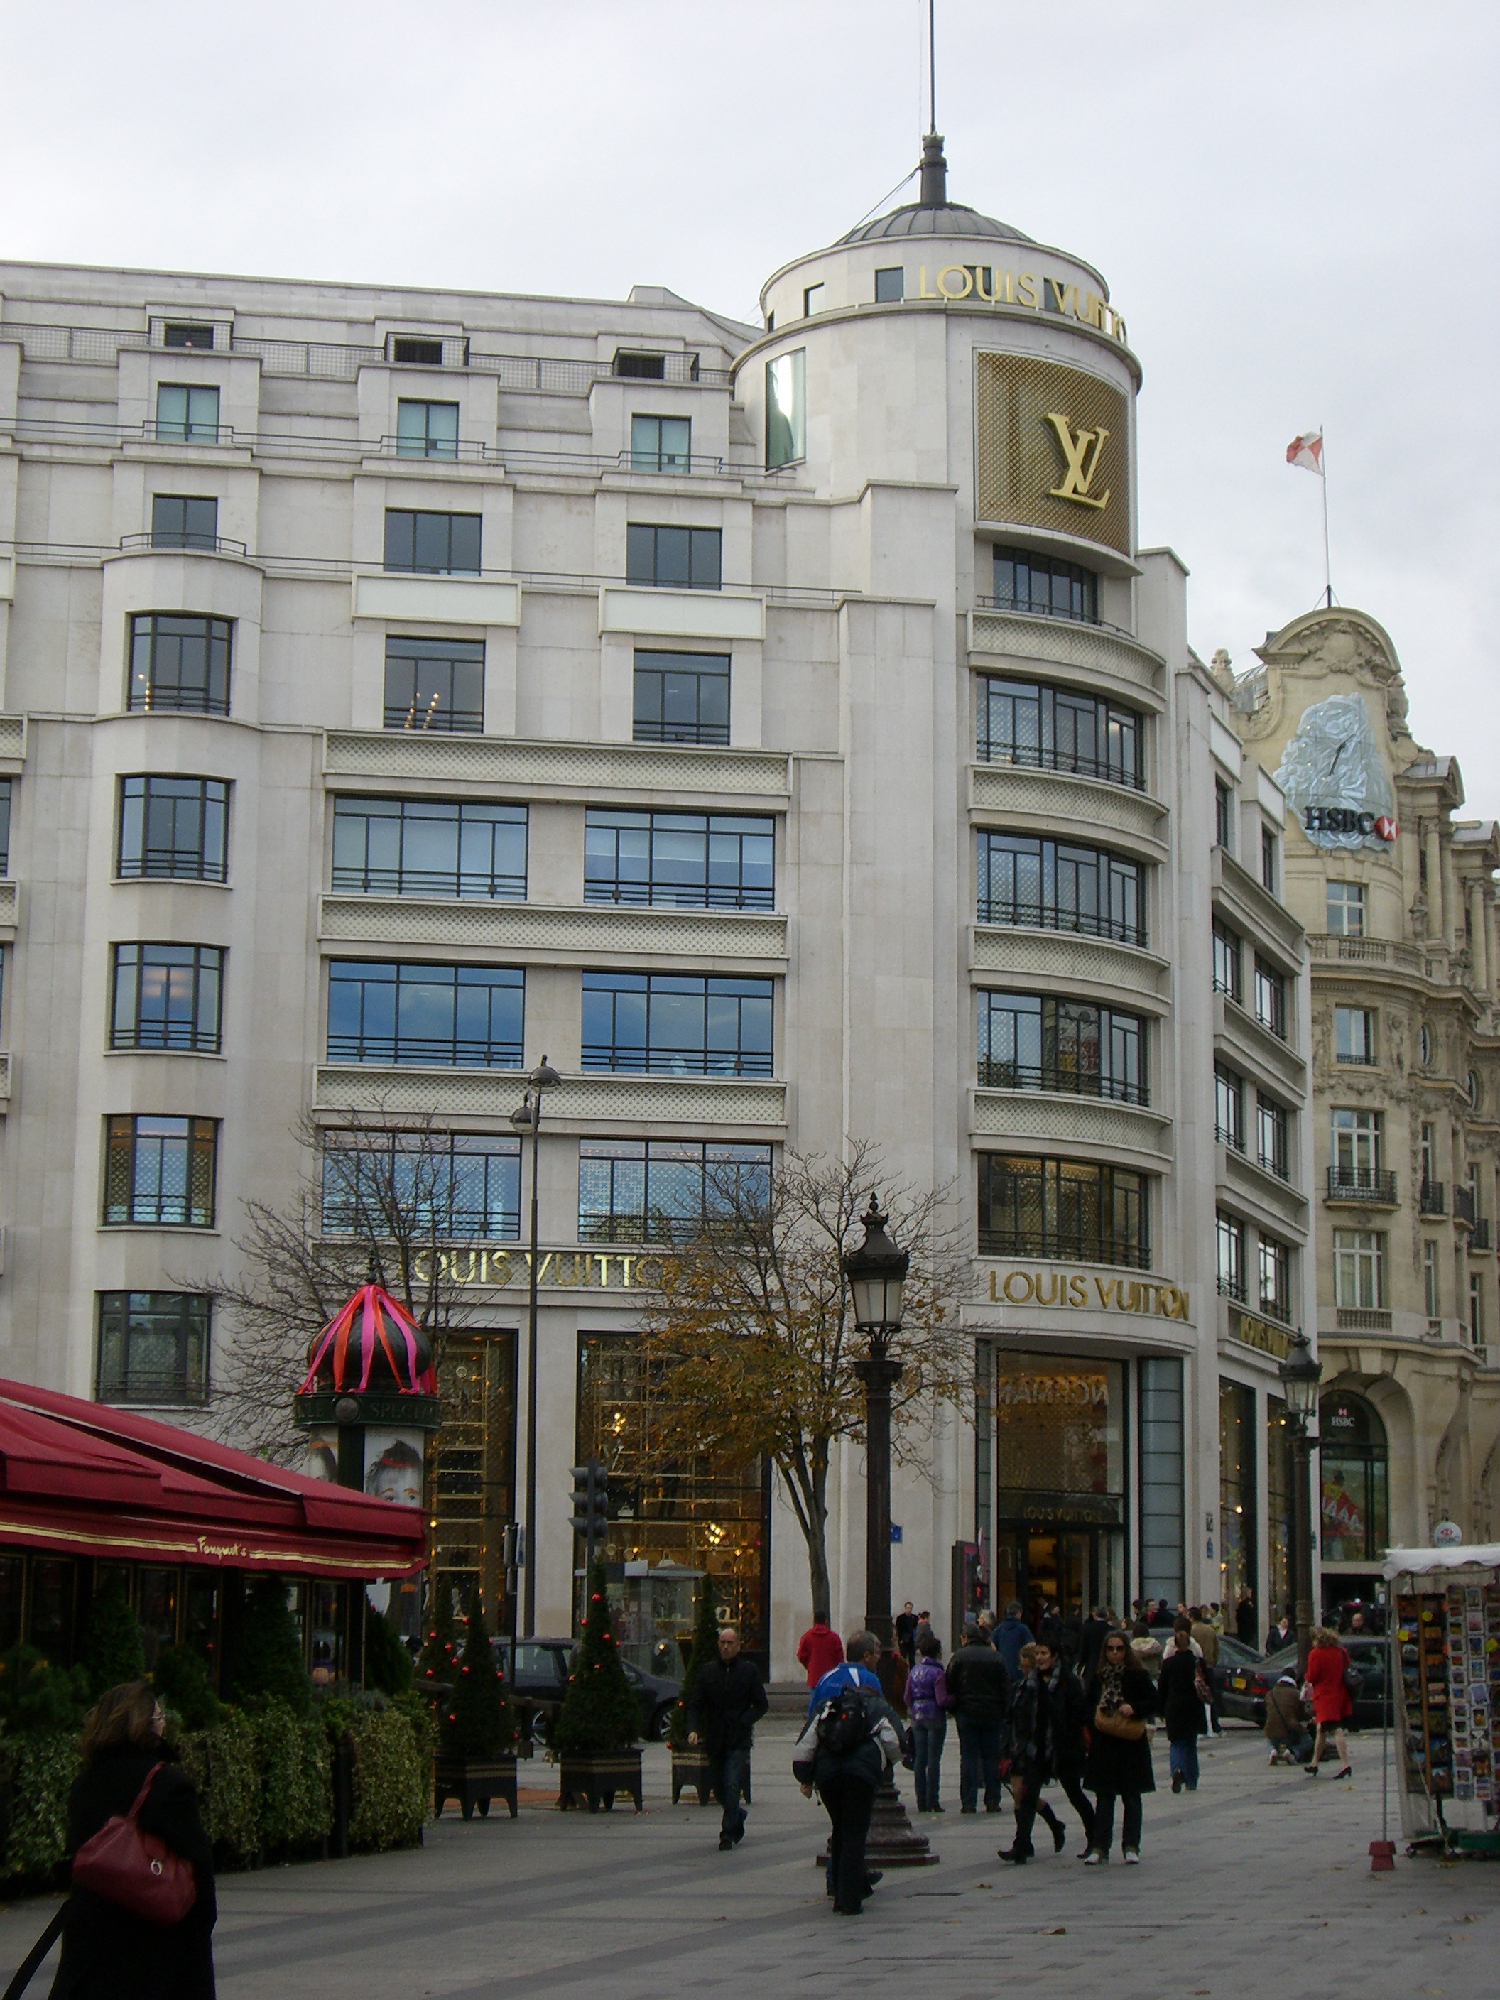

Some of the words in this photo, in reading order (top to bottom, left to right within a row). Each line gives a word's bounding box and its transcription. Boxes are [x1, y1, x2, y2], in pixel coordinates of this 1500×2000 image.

[919, 264, 1039, 307] LOUIS
[1050, 278, 1127, 344] VUITTO
[1305, 806, 1375, 835] HSBC
[397, 1249, 512, 1284] OUIS
[525, 1251, 672, 1289] VUITTO
[990, 1270, 1089, 1308] LOUIS
[1095, 1277, 1190, 1321] VUITTON
